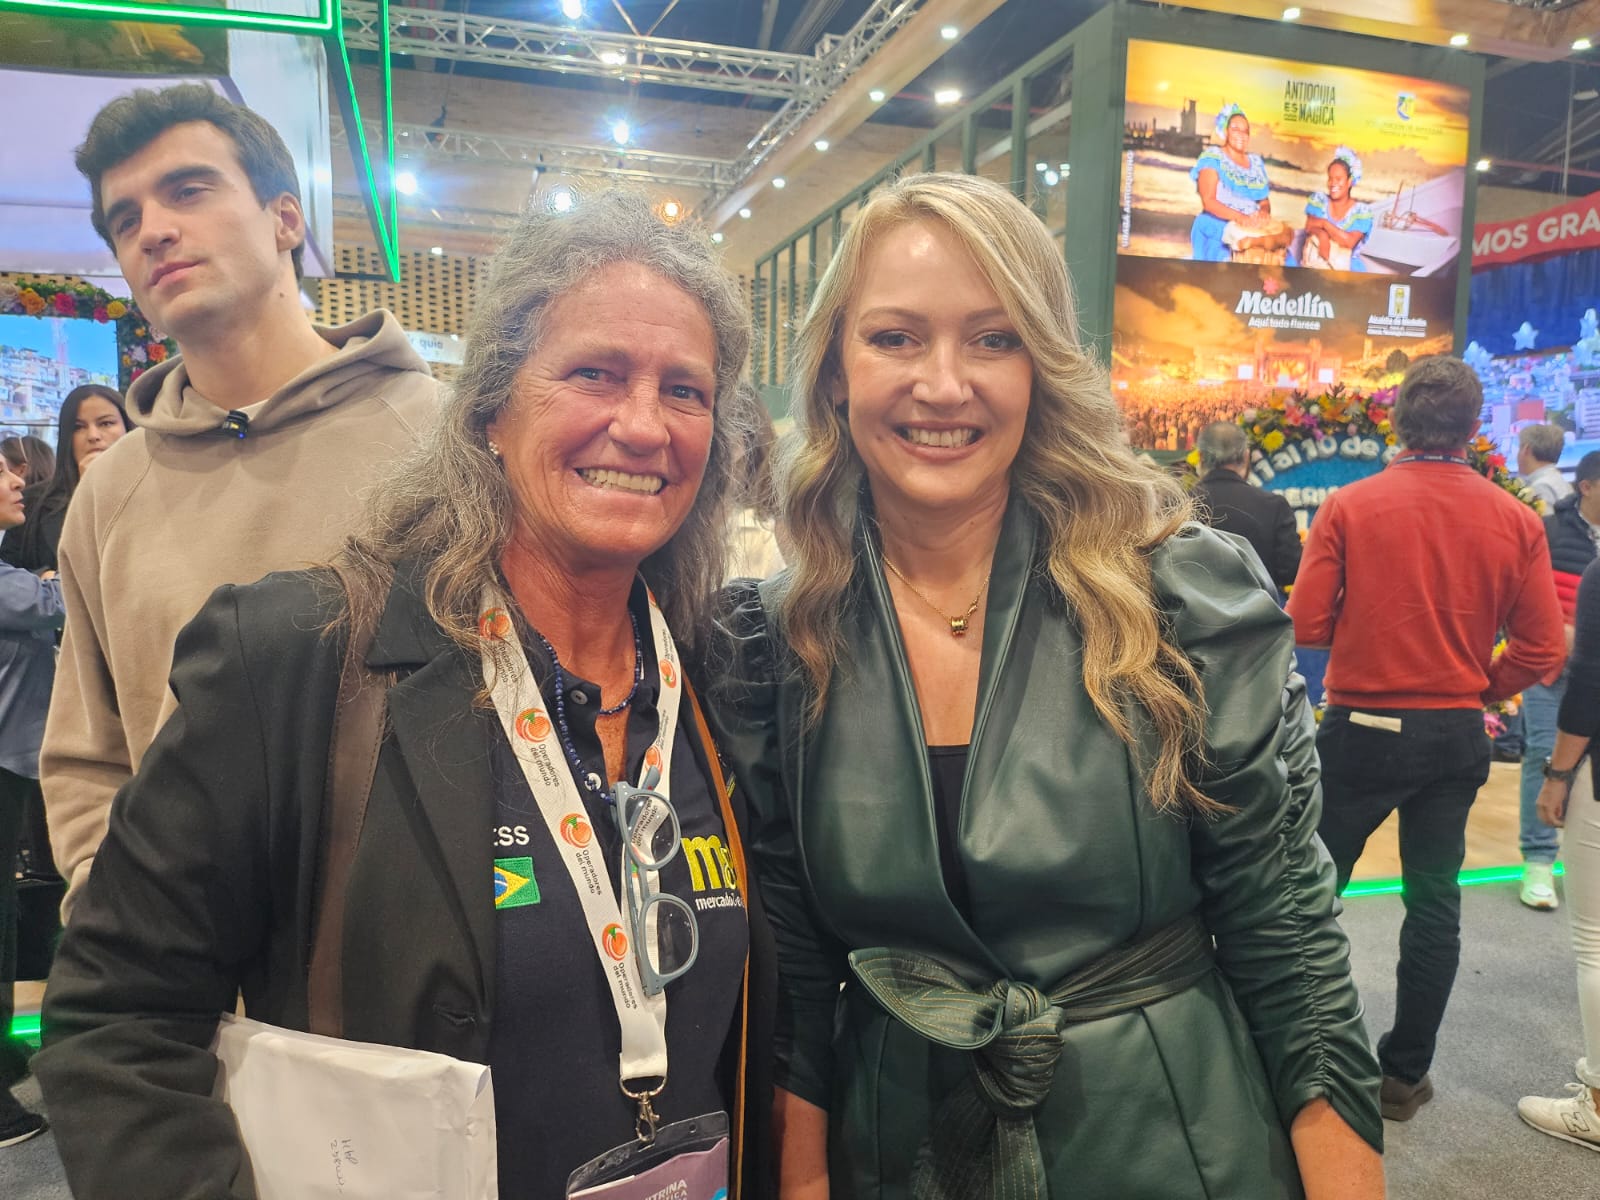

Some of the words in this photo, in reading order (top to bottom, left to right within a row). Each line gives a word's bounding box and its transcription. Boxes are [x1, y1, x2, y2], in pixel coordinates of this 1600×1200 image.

[1284, 102, 1298, 113] ES
[1285, 81, 1336, 105] ANTIOQUIA
[1235, 291, 1334, 318] Medellín
[1301, 436, 1338, 461] 10
[1340, 436, 1380, 461] de
[530, 747, 539, 761] del
[535, 760, 551, 786] mundo
[539, 743, 559, 788] Operadores
[632, 799, 652, 843] Operadores
[581, 866, 595, 894] mundo
[582, 850, 601, 895] Operadores
[618, 962, 637, 1009] Operadores
[618, 978, 631, 1009] mundo
